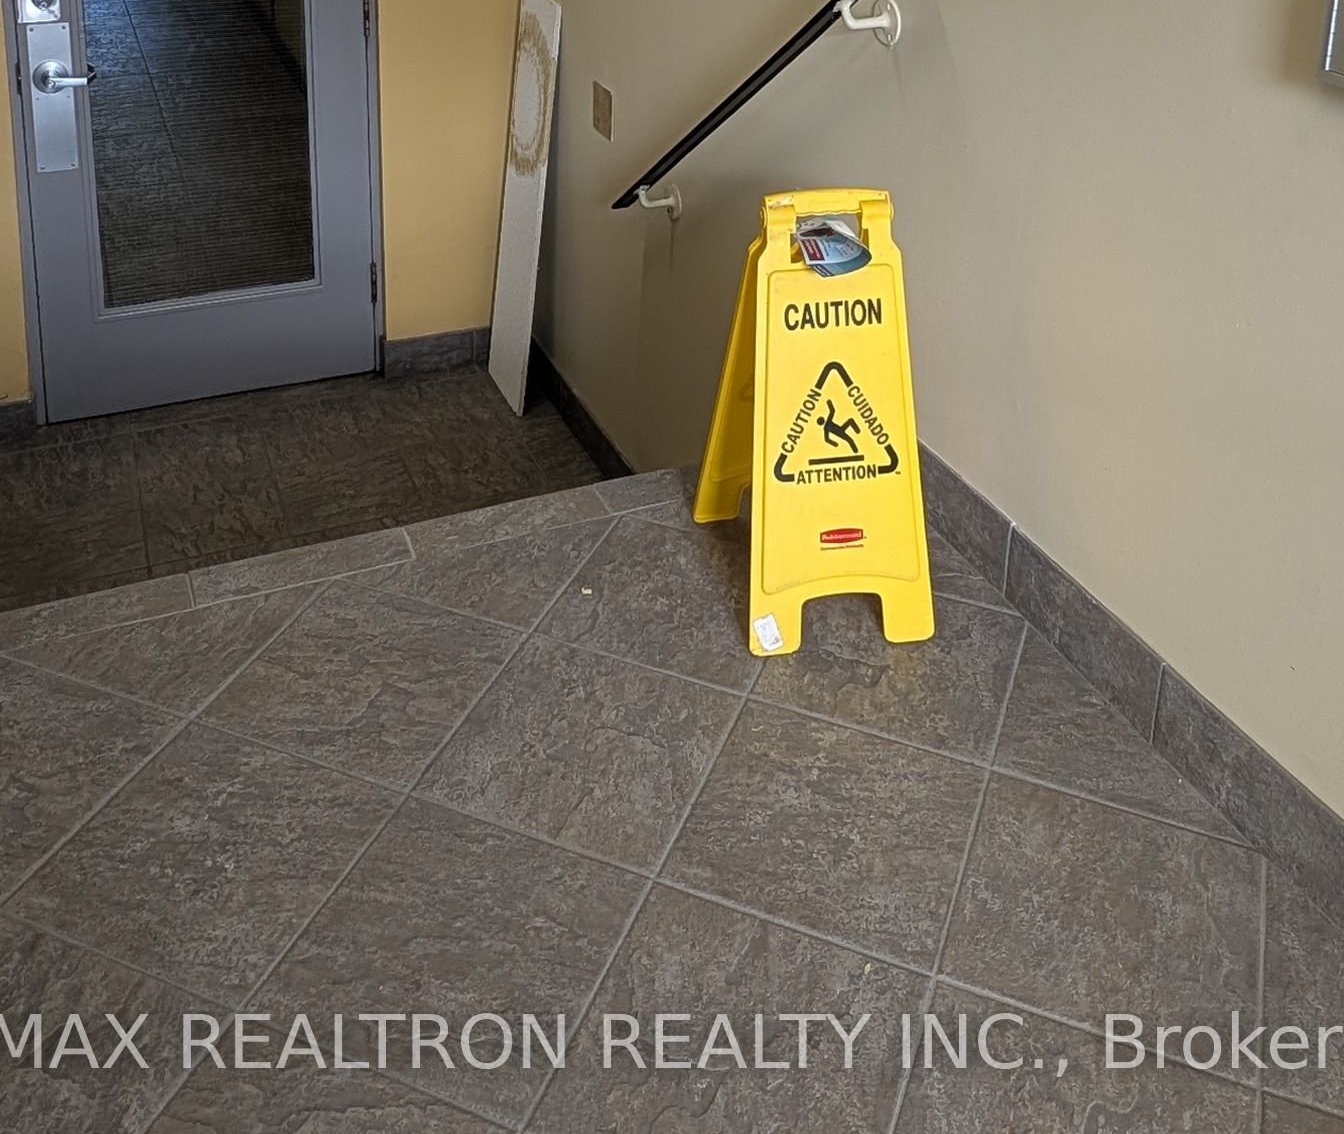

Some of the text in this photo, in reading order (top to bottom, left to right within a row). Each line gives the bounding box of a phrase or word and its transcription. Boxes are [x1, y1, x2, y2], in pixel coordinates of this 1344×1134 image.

[783, 298, 882, 331] CAUTION
[781, 388, 821, 454] CAUTION
[847, 386, 889, 446] CUIDADO
[796, 464, 877, 485] ATTENTION
